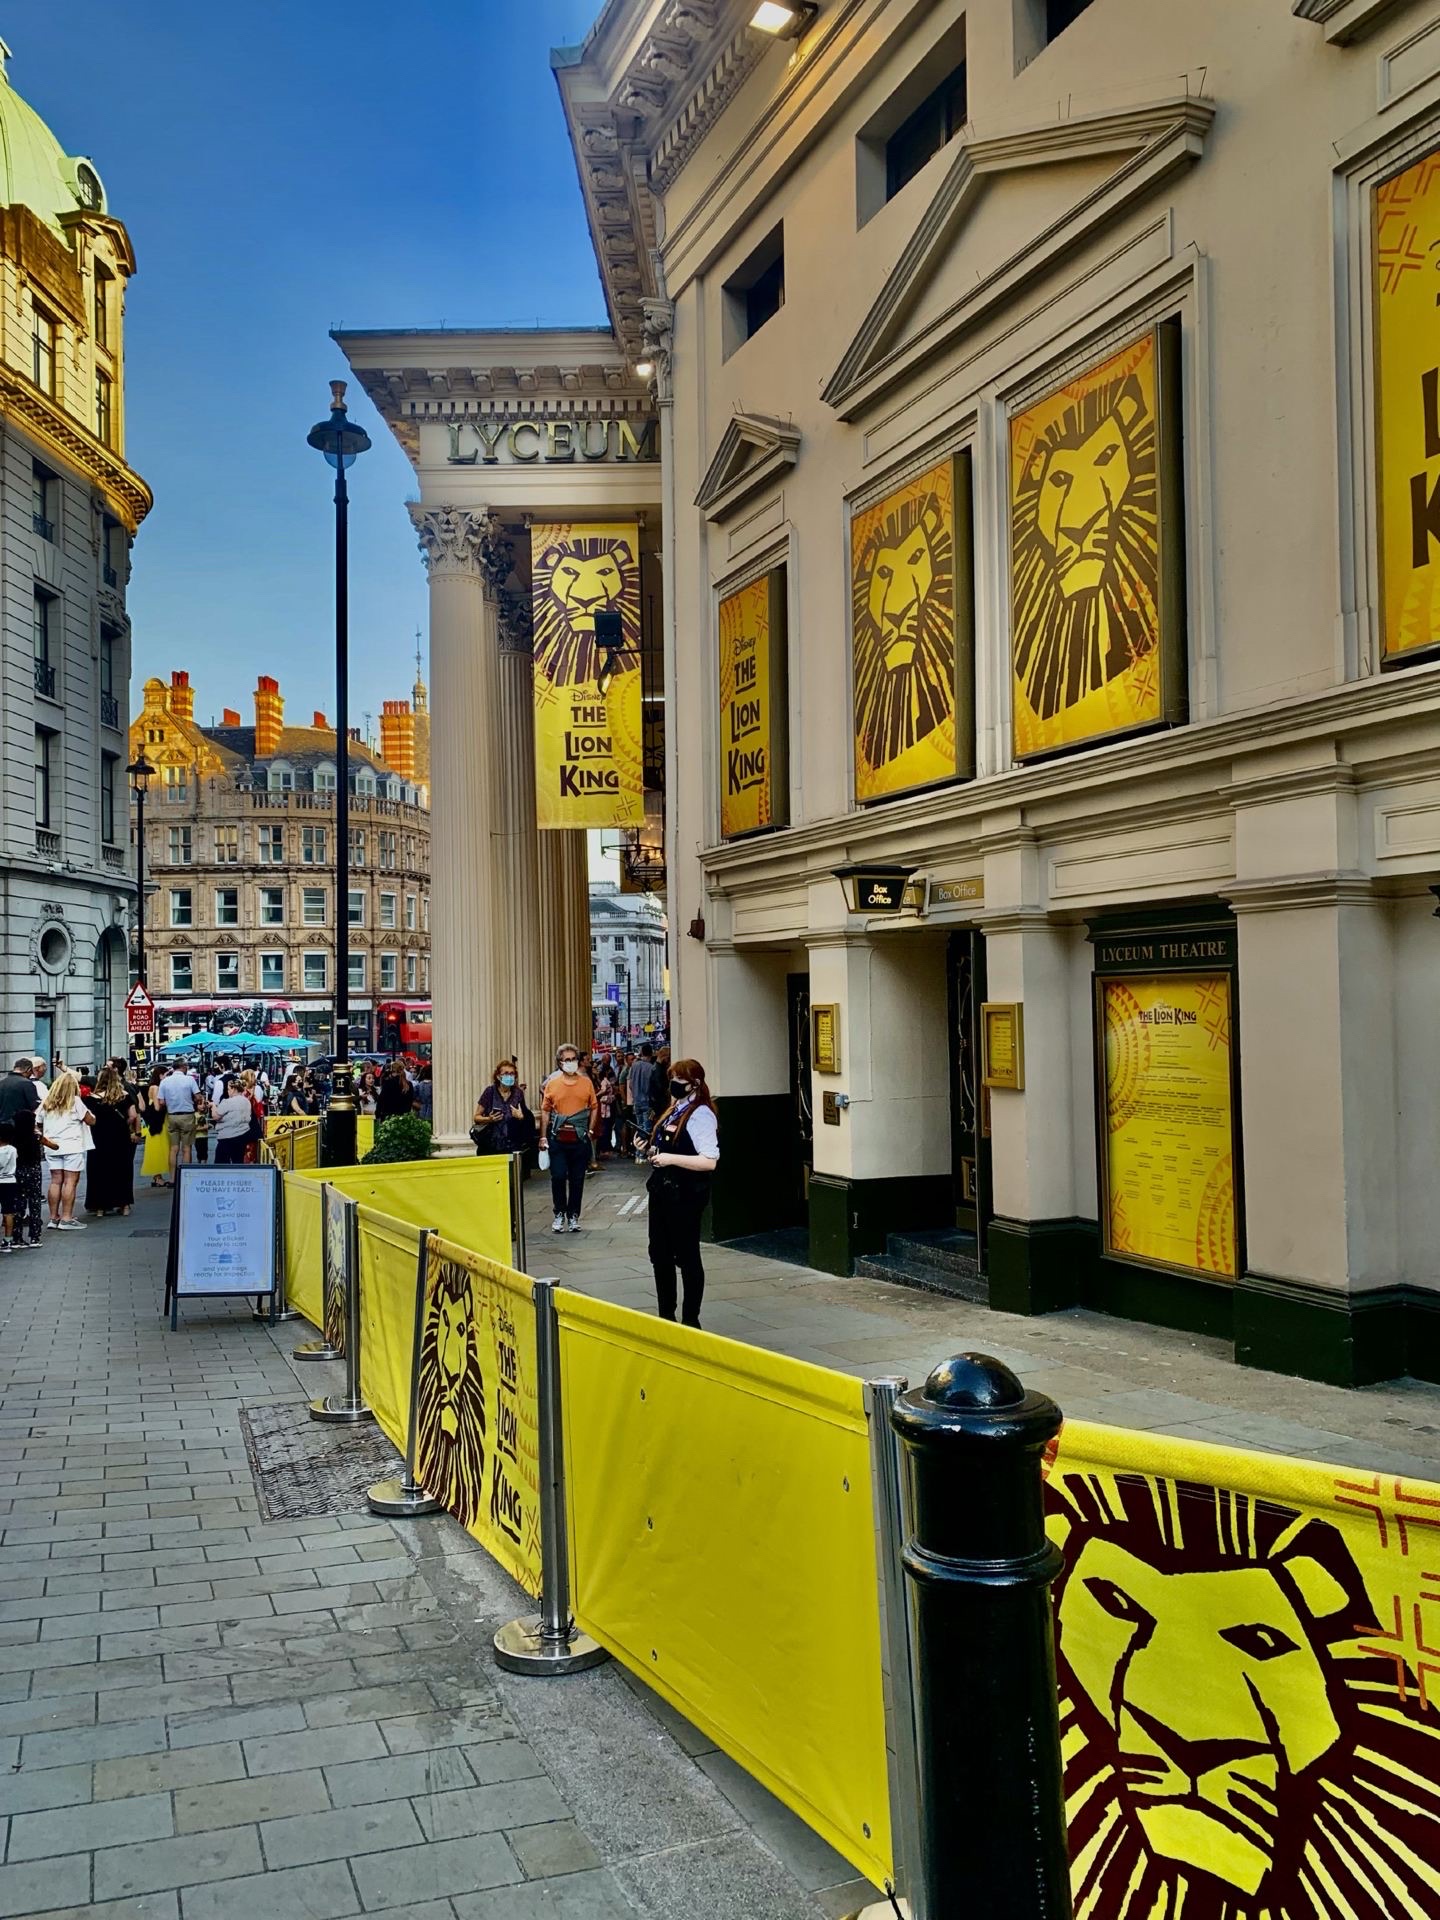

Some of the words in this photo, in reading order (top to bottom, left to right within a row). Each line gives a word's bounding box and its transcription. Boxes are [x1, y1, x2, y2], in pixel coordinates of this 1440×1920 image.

[446, 420, 660, 463] LYCEUM
[732, 636, 756, 656] Disney
[734, 655, 756, 687] THE
[571, 706, 606, 722] THE
[730, 699, 760, 744] LION
[564, 731, 612, 761] LION
[560, 764, 619, 798] KING
[728, 747, 764, 796] KING
[868, 894, 892, 904] Office
[873, 884, 888, 894] Box
[938, 888, 951, 900] Box
[952, 884, 976, 898] Office
[1102, 945, 1153, 962] LYCEUM
[1160, 940, 1227, 959] THEATRE
[1138, 1010, 1153, 1021] THE
[1154, 1008, 1172, 1024] LION
[1174, 1008, 1196, 1025] KING
[498, 1340, 517, 1384] THE
[496, 1388, 517, 1452] LION
[490, 1453, 522, 1530] KING
